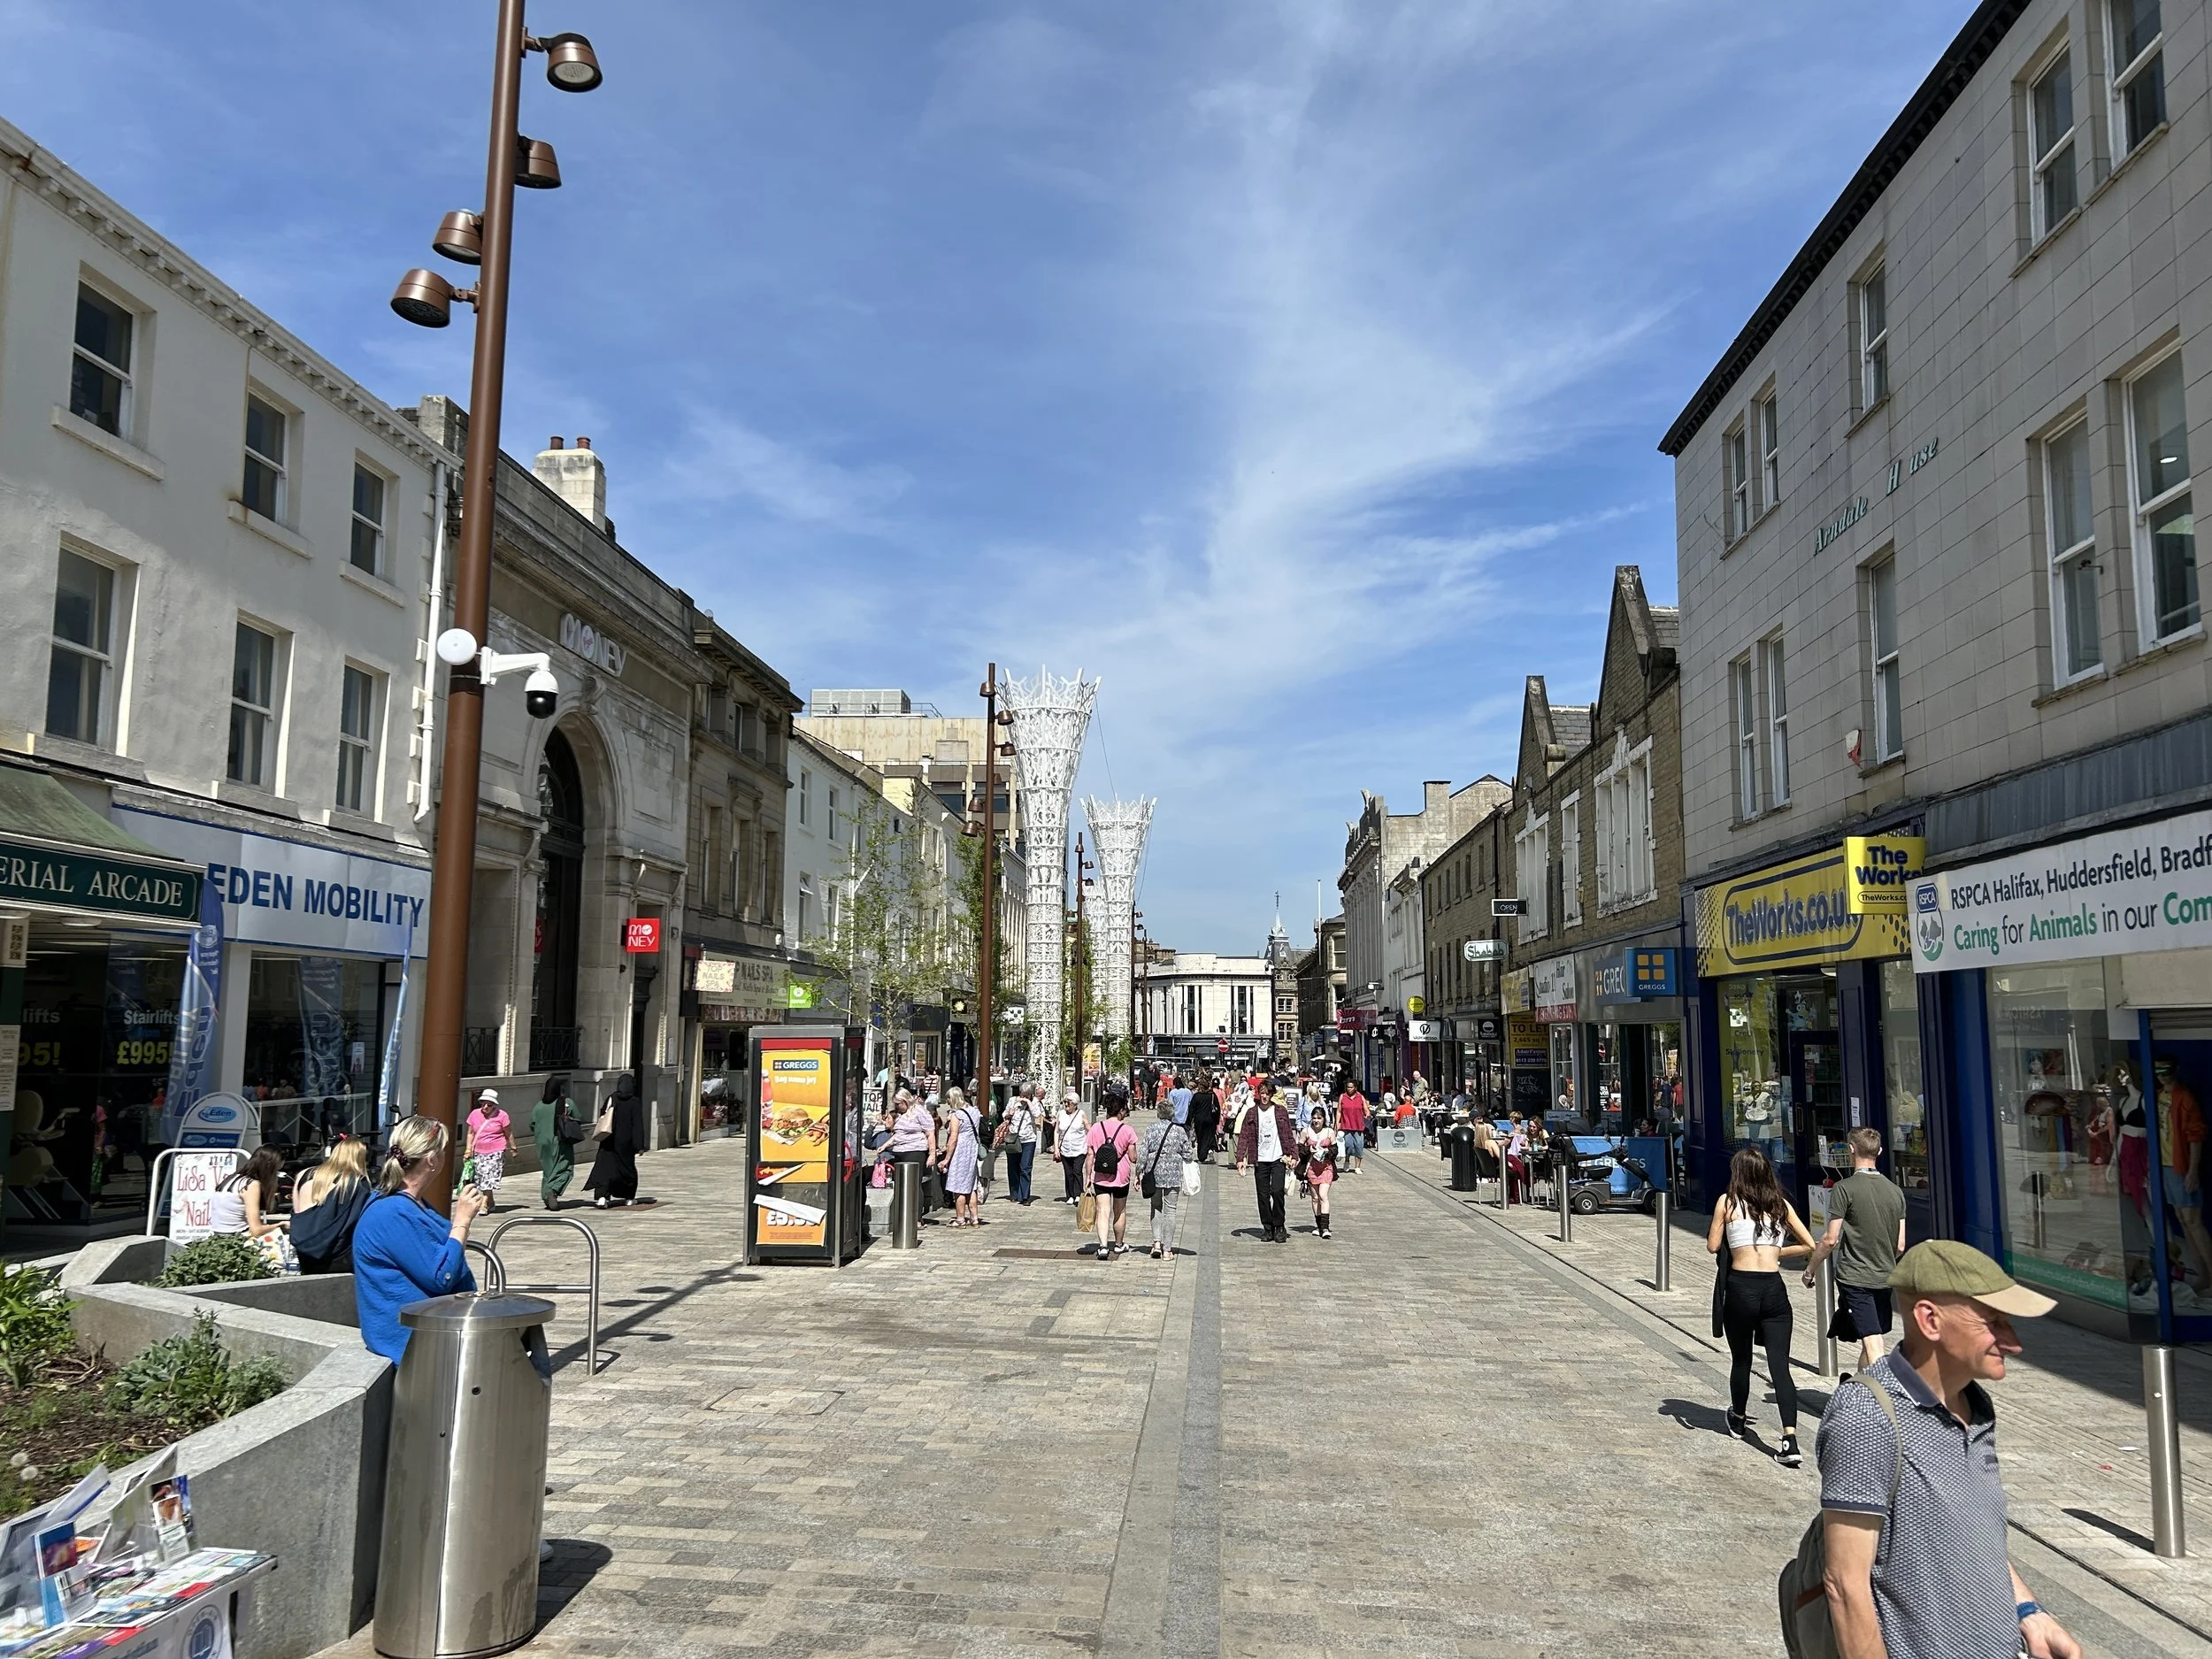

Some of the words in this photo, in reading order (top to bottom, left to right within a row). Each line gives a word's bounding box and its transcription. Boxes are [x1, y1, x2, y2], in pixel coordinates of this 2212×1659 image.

[1814, 496, 1868, 557] Arndale
[1867, 845, 1908, 864] The
[87, 871, 183, 907] ARCADE
[1951, 882, 1992, 910] RSPCA
[1993, 872, 2044, 903] Halifax,
[2047, 847, 2157, 895] Huddersfield,
[207, 863, 292, 910] EDEN
[304, 879, 425, 928] MOBILITY
[1918, 891, 1936, 905] RSPCA
[1954, 921, 2000, 956] Caring
[2002, 915, 2024, 945] for
[2029, 903, 2098, 942] Animals
[2102, 903, 2119, 933] in
[2124, 903, 2158, 930] our
[2163, 892, 2212, 926] Com
[706, 979, 719, 988] SPA
[123, 1010, 180, 1025] Stairlifts
[1511, 1024, 1525, 1033] TO
[1530, 1024, 1548, 1033] LET
